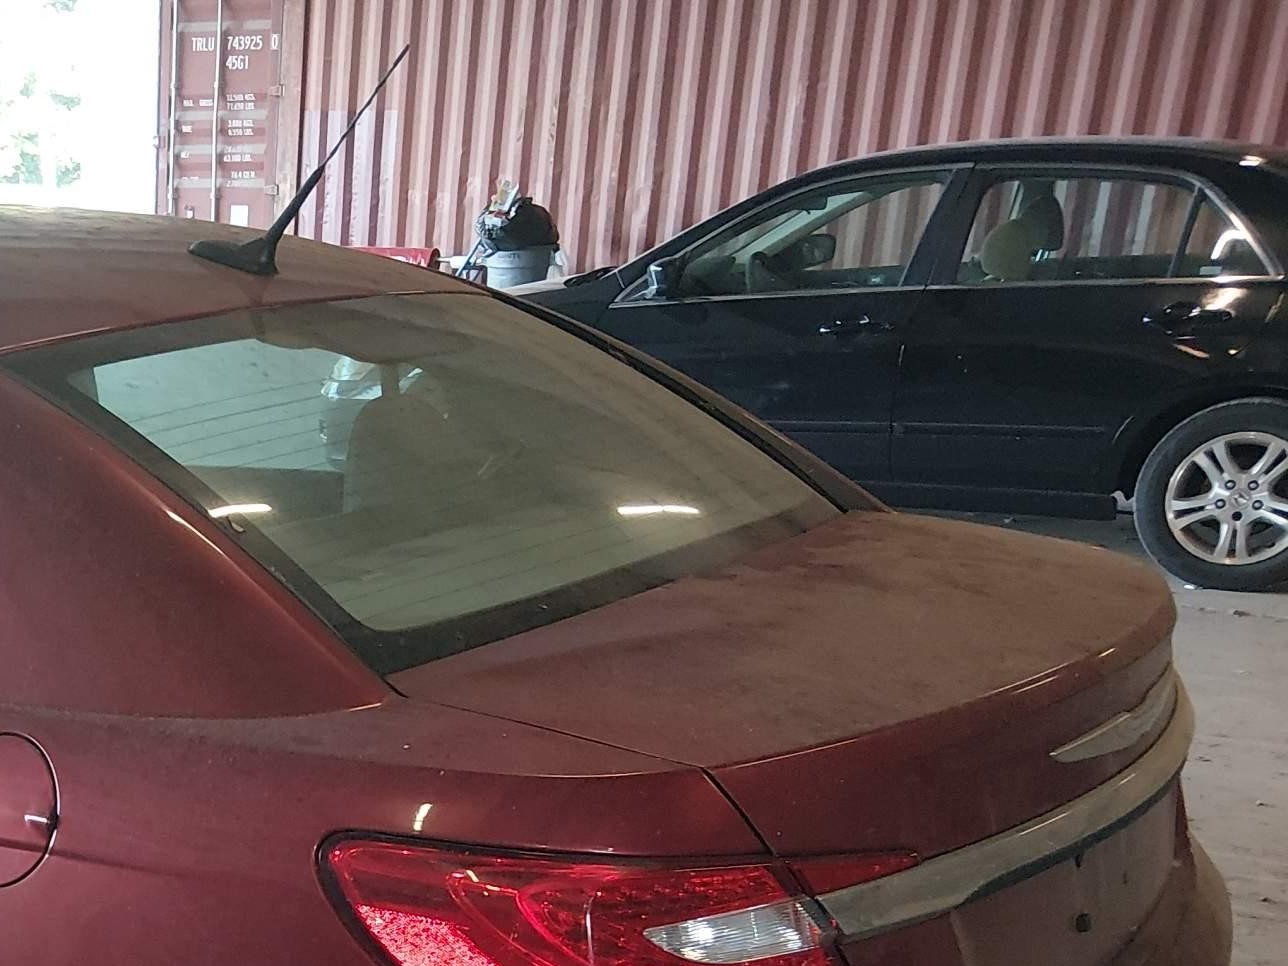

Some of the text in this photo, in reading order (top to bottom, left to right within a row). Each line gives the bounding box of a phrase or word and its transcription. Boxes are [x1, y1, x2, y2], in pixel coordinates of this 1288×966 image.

[192, 37, 215, 52] TRLU
[227, 36, 263, 51] 743925
[226, 56, 249, 70] 45G1
